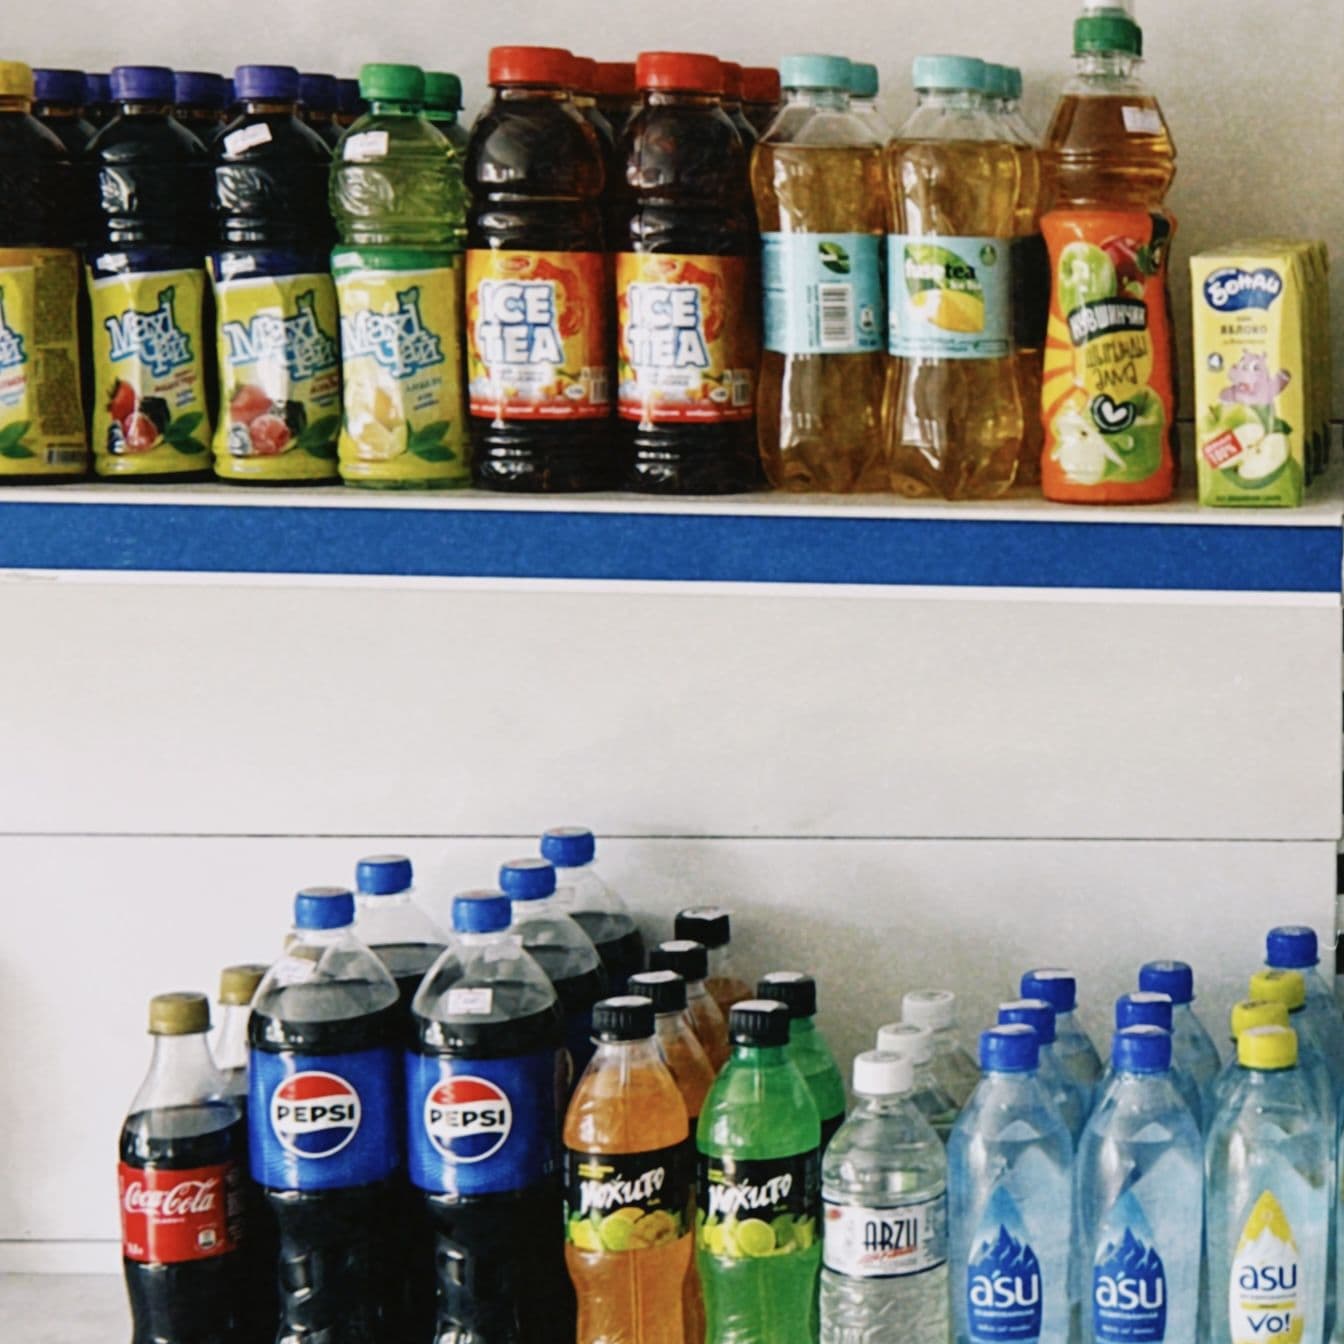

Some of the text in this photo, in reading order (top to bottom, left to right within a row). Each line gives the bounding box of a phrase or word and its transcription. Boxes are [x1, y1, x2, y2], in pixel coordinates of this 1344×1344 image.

[480, 282, 554, 324] ICE
[628, 284, 701, 328] ICE
[480, 323, 565, 365] TEA
[628, 327, 709, 369] TEA
[275, 1102, 356, 1123] PEPSI
[430, 1107, 508, 1128] PEPSI
[863, 1218, 919, 1252] ARZU
[1239, 1262, 1298, 1291] asu
